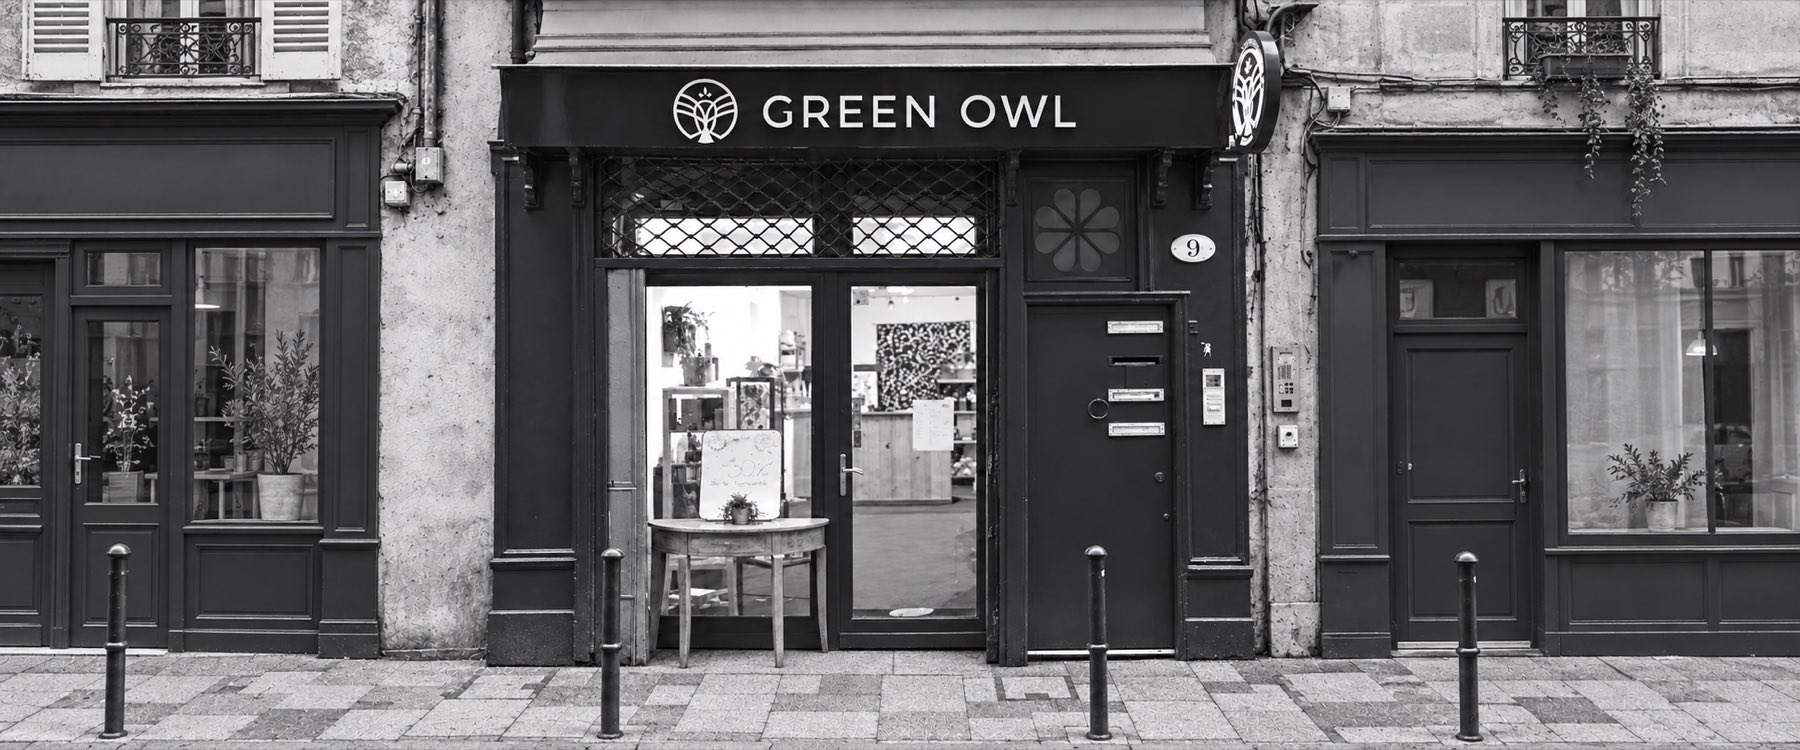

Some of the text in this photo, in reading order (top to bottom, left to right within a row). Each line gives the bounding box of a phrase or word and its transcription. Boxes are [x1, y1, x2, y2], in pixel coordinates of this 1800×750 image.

[763, 95, 1077, 128] GREEN OWL
[1187, 239, 1200, 257] 9
